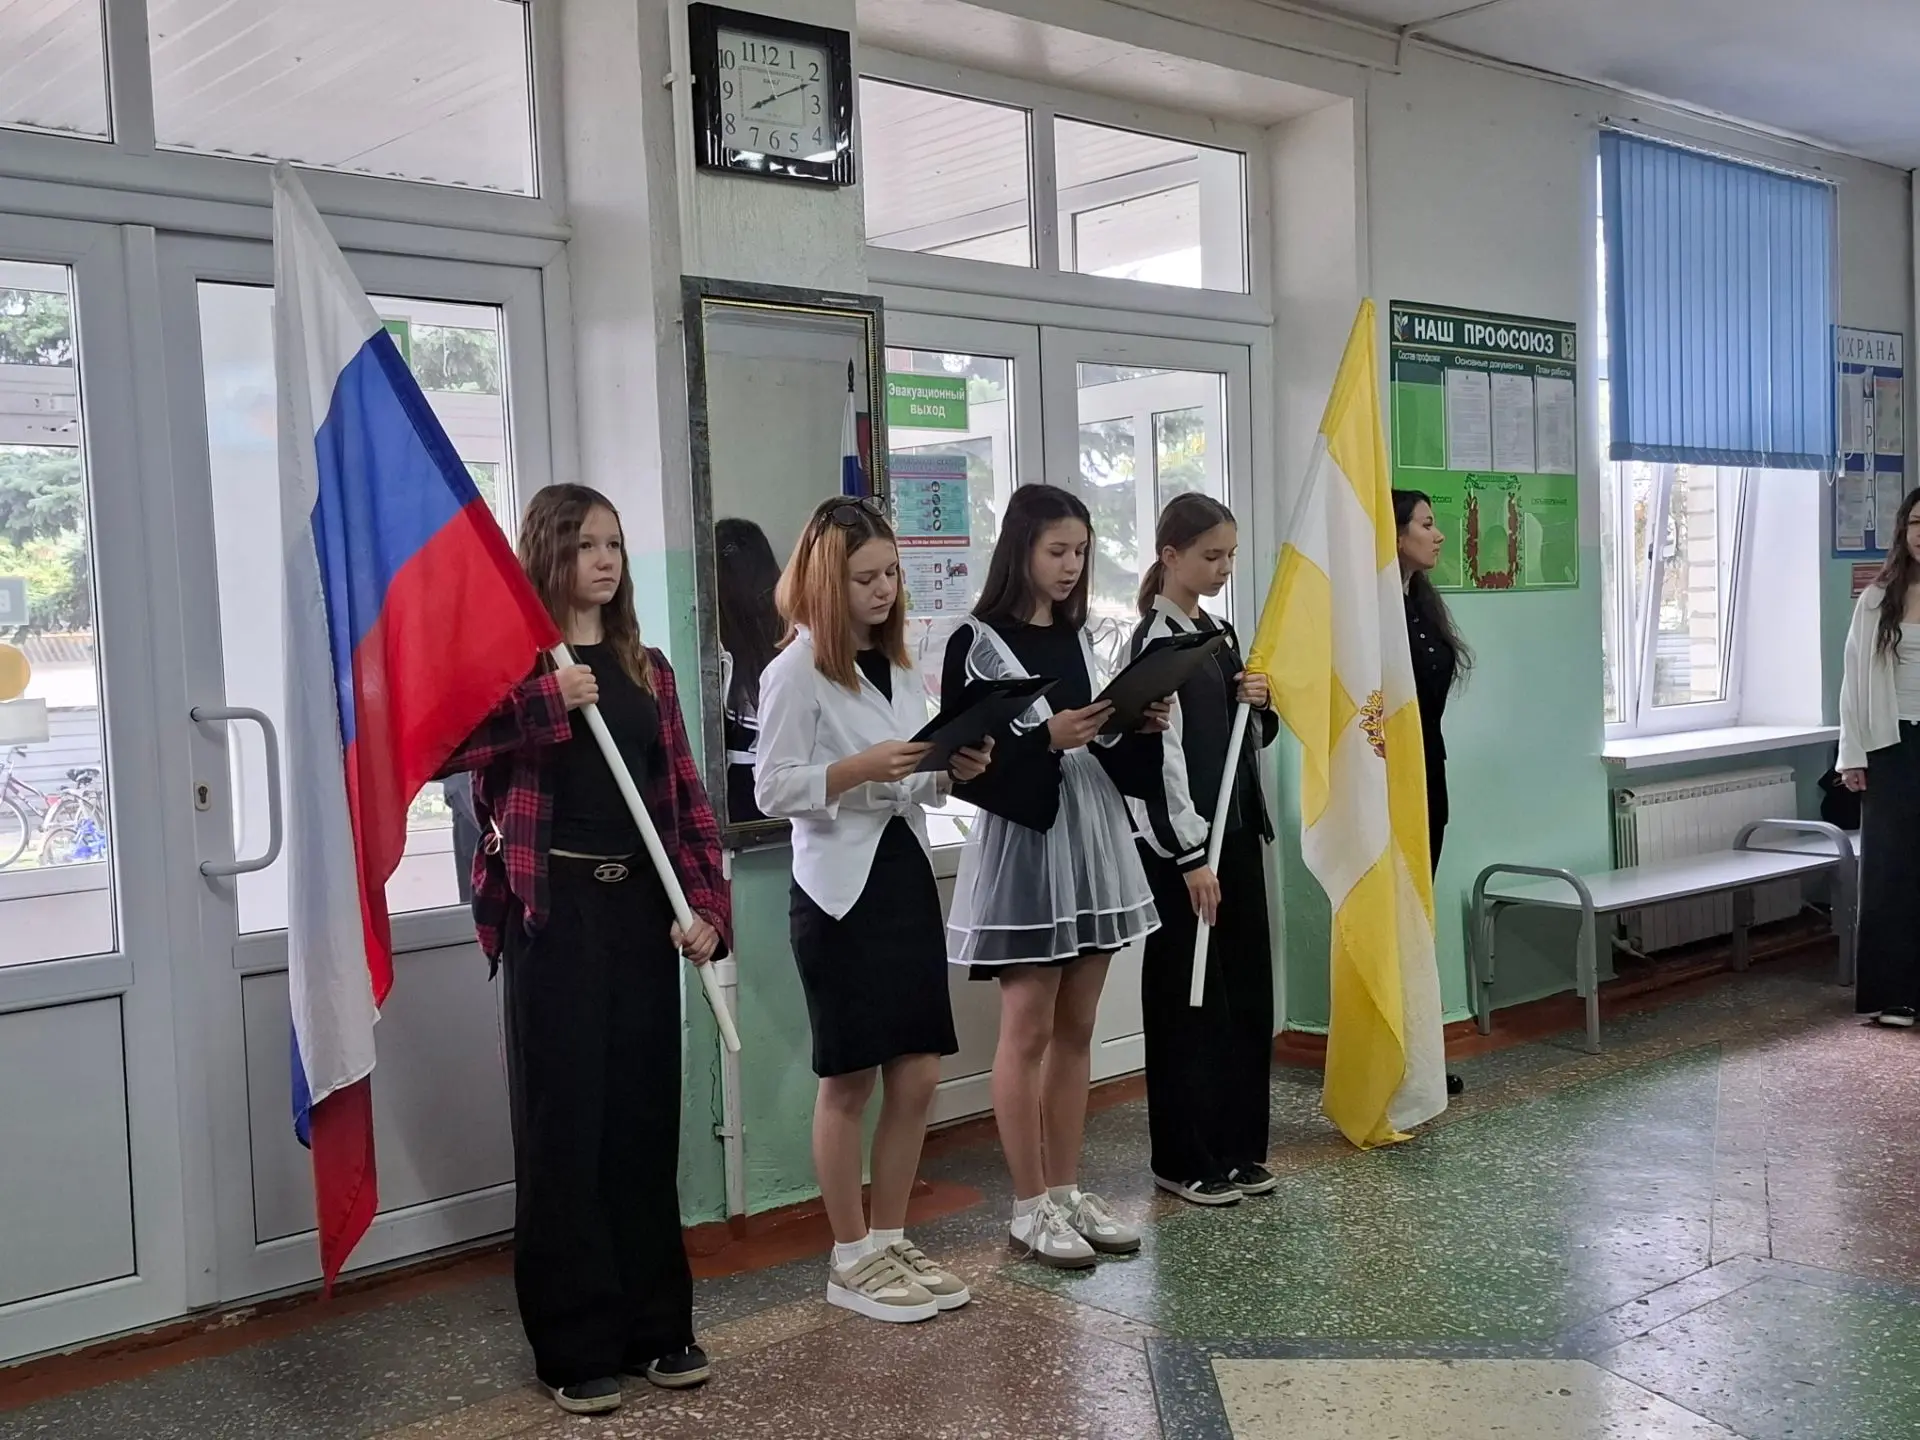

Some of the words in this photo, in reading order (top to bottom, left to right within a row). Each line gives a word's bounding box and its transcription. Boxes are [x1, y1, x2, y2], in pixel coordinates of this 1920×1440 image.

[718, 49, 735, 70] 10
[742, 41, 757, 63] 11
[762, 45, 780, 66] 12
[789, 50, 796, 69] 1
[808, 62, 820, 82] 2
[722, 81, 734, 100] 9
[811, 95, 821, 115] 3
[725, 112, 736, 135] 8
[749, 127, 760, 147] 7
[769, 130, 780, 150] 6
[789, 132, 799, 153] 5
[812, 126, 822, 146] 4
[1414, 317, 1454, 343] НАШ
[1464, 323, 1554, 354] ПРОФСОЮЗ
[1836, 336, 1896, 362] ОХРАНА
[1454, 355, 1488, 369] Основные
[1489, 361, 1524, 371] документы
[888, 382, 965, 400] Эвакуационный
[910, 404, 946, 418] выход
